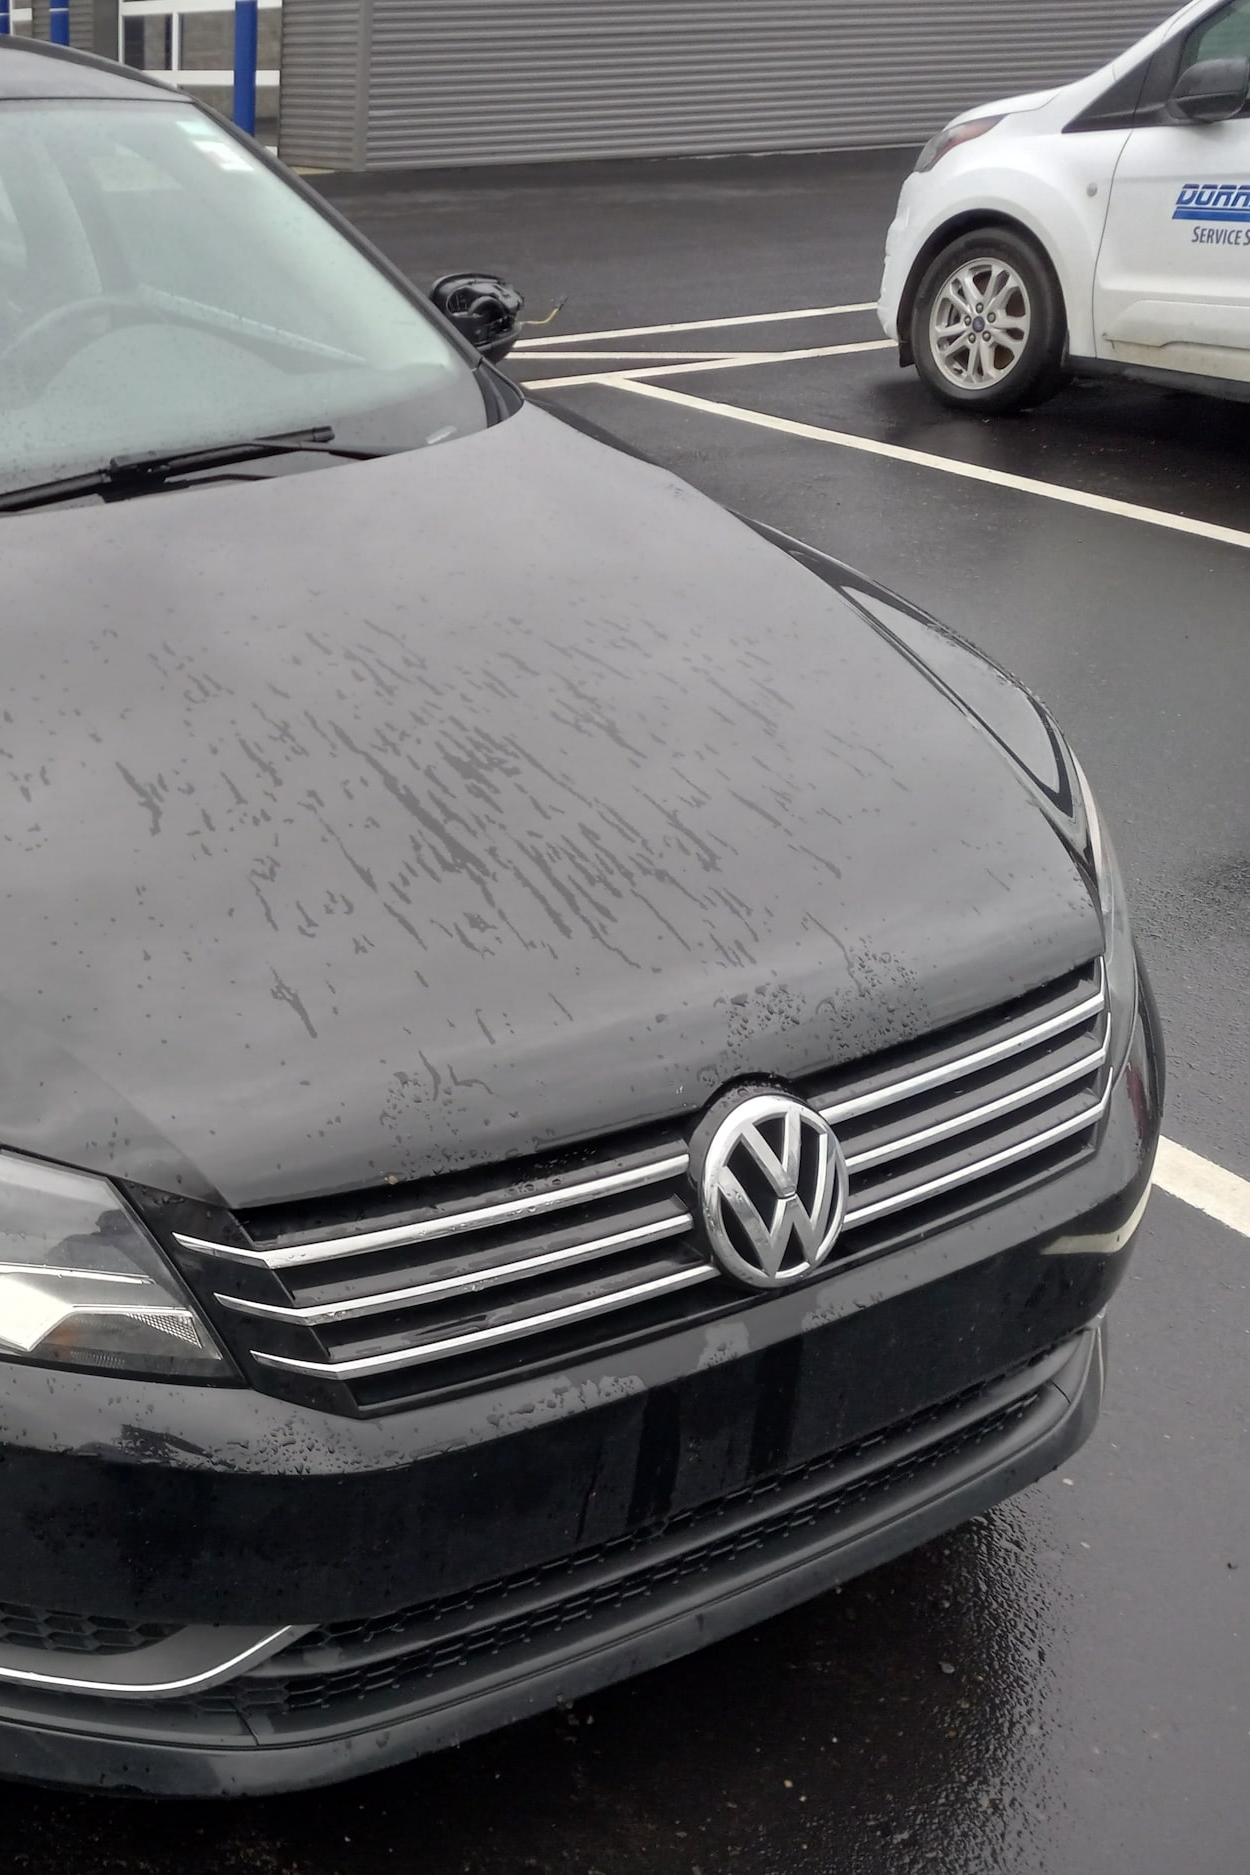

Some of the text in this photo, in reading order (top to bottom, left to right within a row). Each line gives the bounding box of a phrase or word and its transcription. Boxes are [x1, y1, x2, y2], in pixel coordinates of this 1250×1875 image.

[1175, 183, 1250, 206] DORR
[1191, 226, 1243, 245] SERVICE
[706, 1098, 846, 1285] VW
